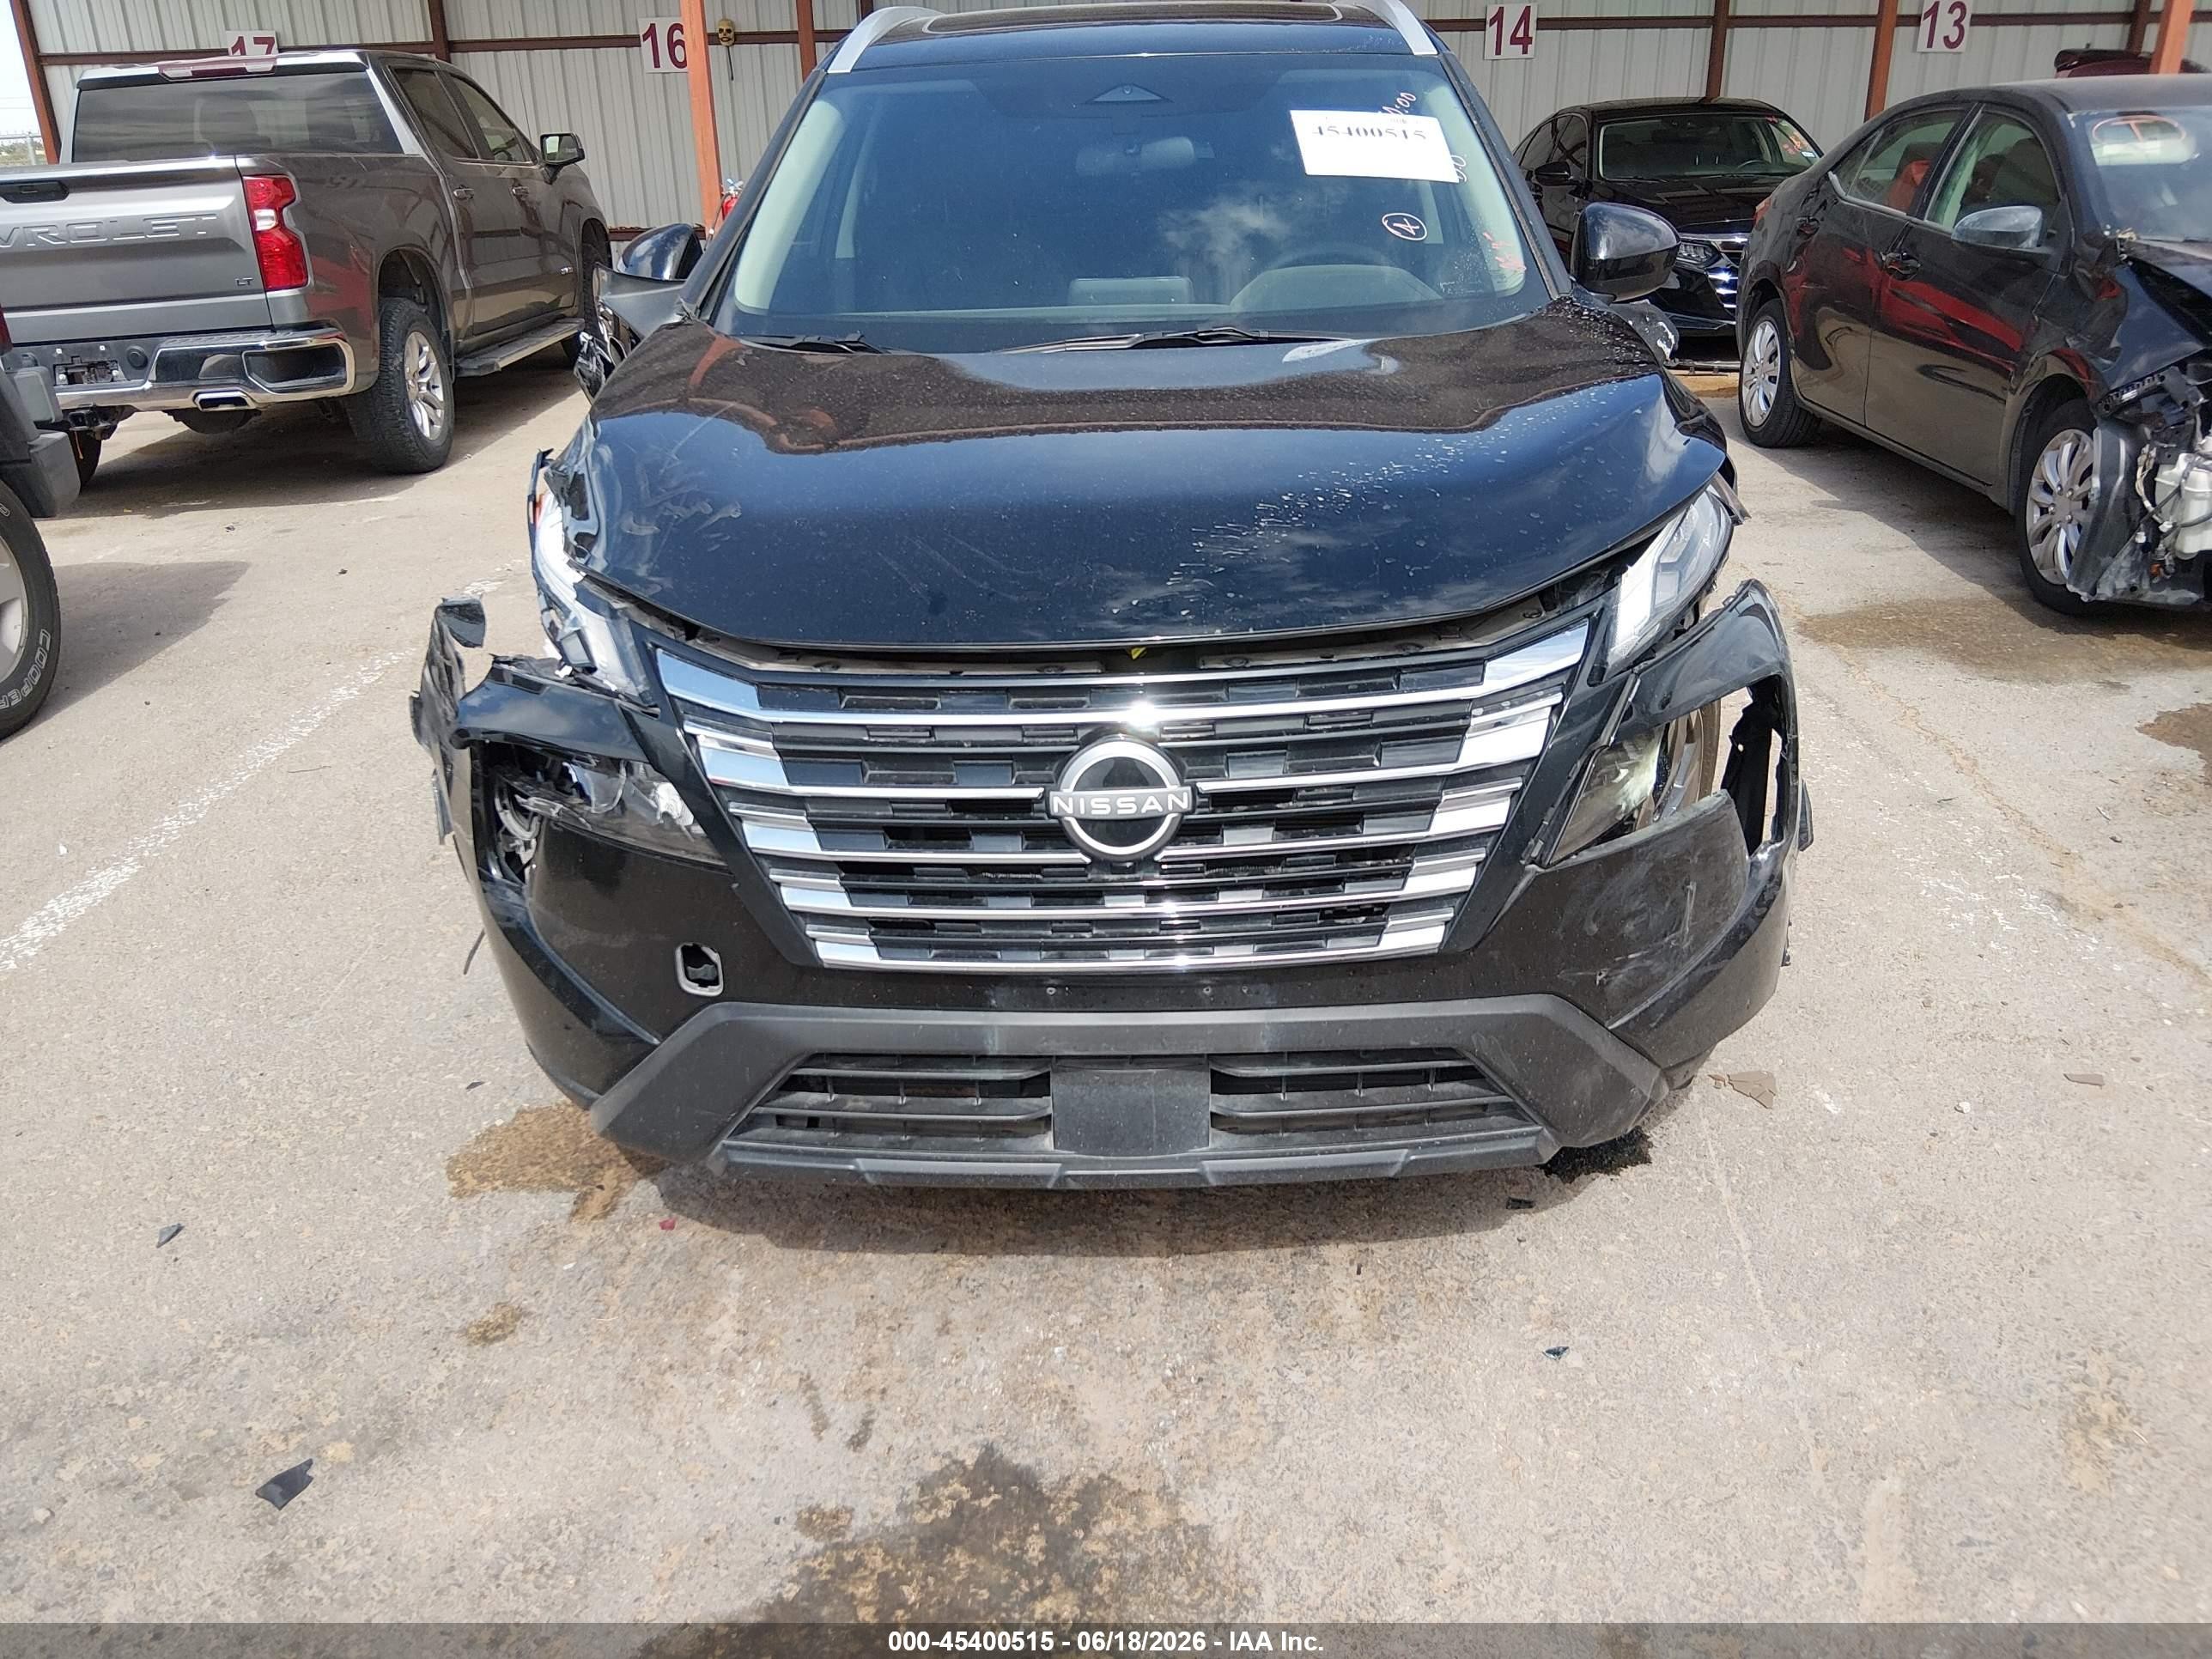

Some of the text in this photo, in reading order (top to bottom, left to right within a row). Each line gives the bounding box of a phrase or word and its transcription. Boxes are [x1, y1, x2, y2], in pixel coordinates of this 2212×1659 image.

[642, 23, 687, 69] 16
[1488, 6, 1533, 55] 14
[1923, 1, 1966, 49] 13
[234, 277, 253, 286] LT
[1053, 791, 1188, 815] NISSAN
